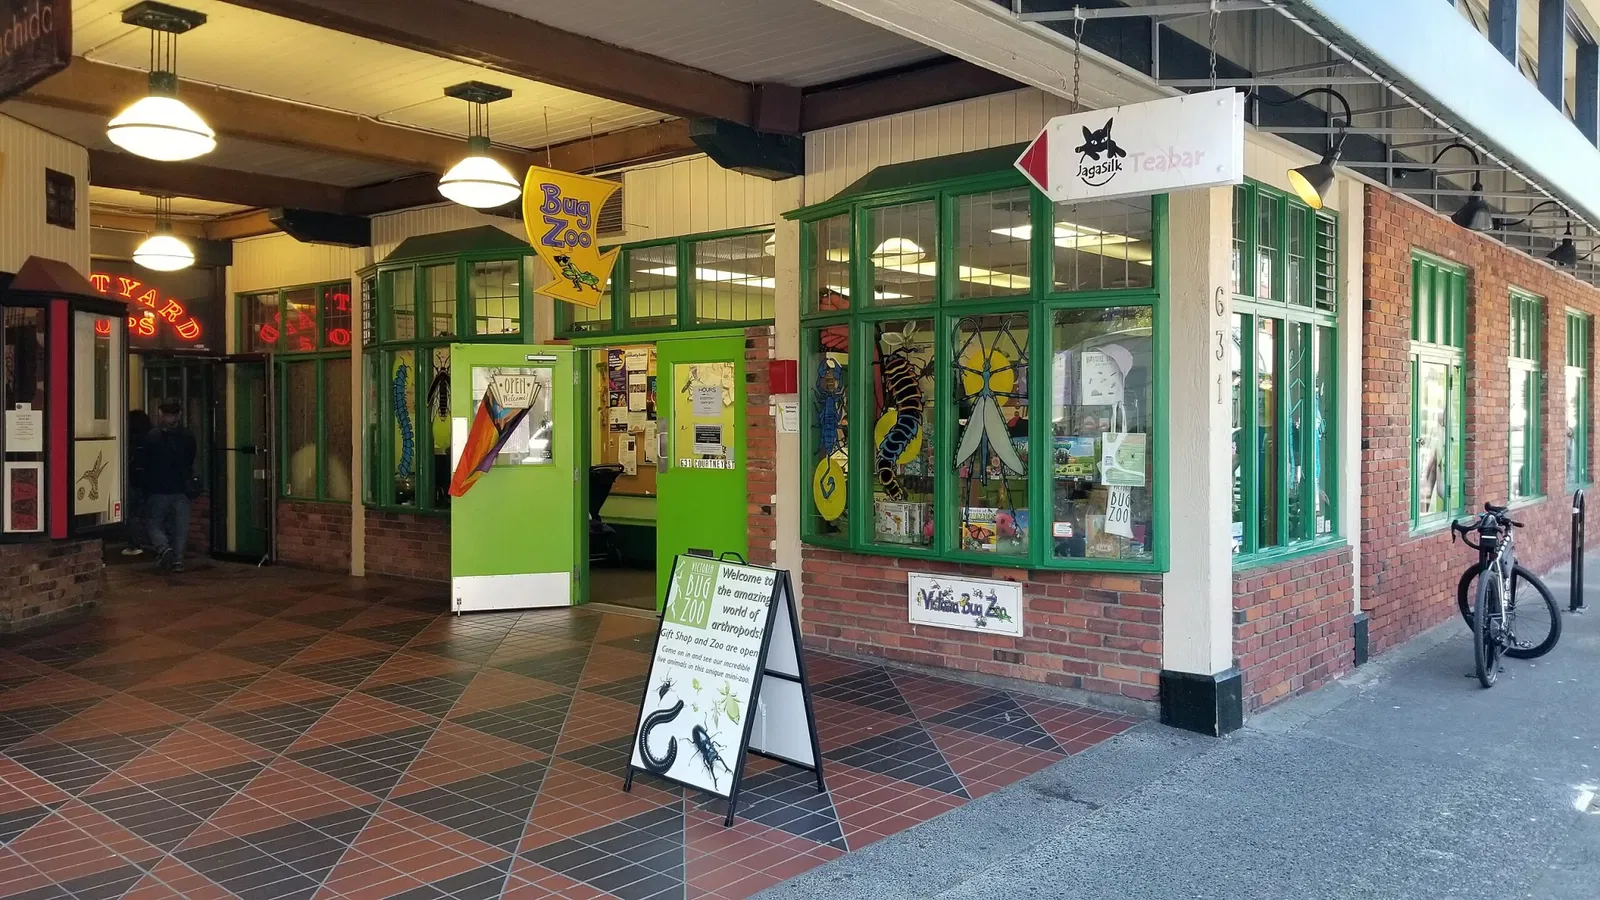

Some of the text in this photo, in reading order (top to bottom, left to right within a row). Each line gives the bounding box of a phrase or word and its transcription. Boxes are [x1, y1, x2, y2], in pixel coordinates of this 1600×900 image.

[1129, 146, 1206, 173] Teabar
[540, 183, 592, 231] Bug
[541, 215, 592, 248] Zoo
[1215, 286, 1225, 404] 631
[504, 378, 526, 394] OPEN
[1108, 506, 1128, 524] ZOO
[691, 562, 714, 574] VICTORIA
[722, 567, 774, 587] Welcome to
[686, 574, 712, 600] BUG
[718, 584, 771, 607] the amazing
[680, 597, 705, 625] ZOO
[722, 605, 761, 622] world of
[920, 588, 1008, 618] Victoria Bug Zoo
[660, 628, 758, 658] Gift Shop and Zoo are open
[712, 621, 764, 640] arthropods!
[657, 656, 666, 664] live
[667, 658, 687, 669] animals
[694, 664, 704, 673] this
[705, 667, 724, 678] unique
[662, 645, 676, 655] Come
[691, 651, 702, 661] and
[713, 658, 723, 667] our
[723, 659, 751, 672] incredible
